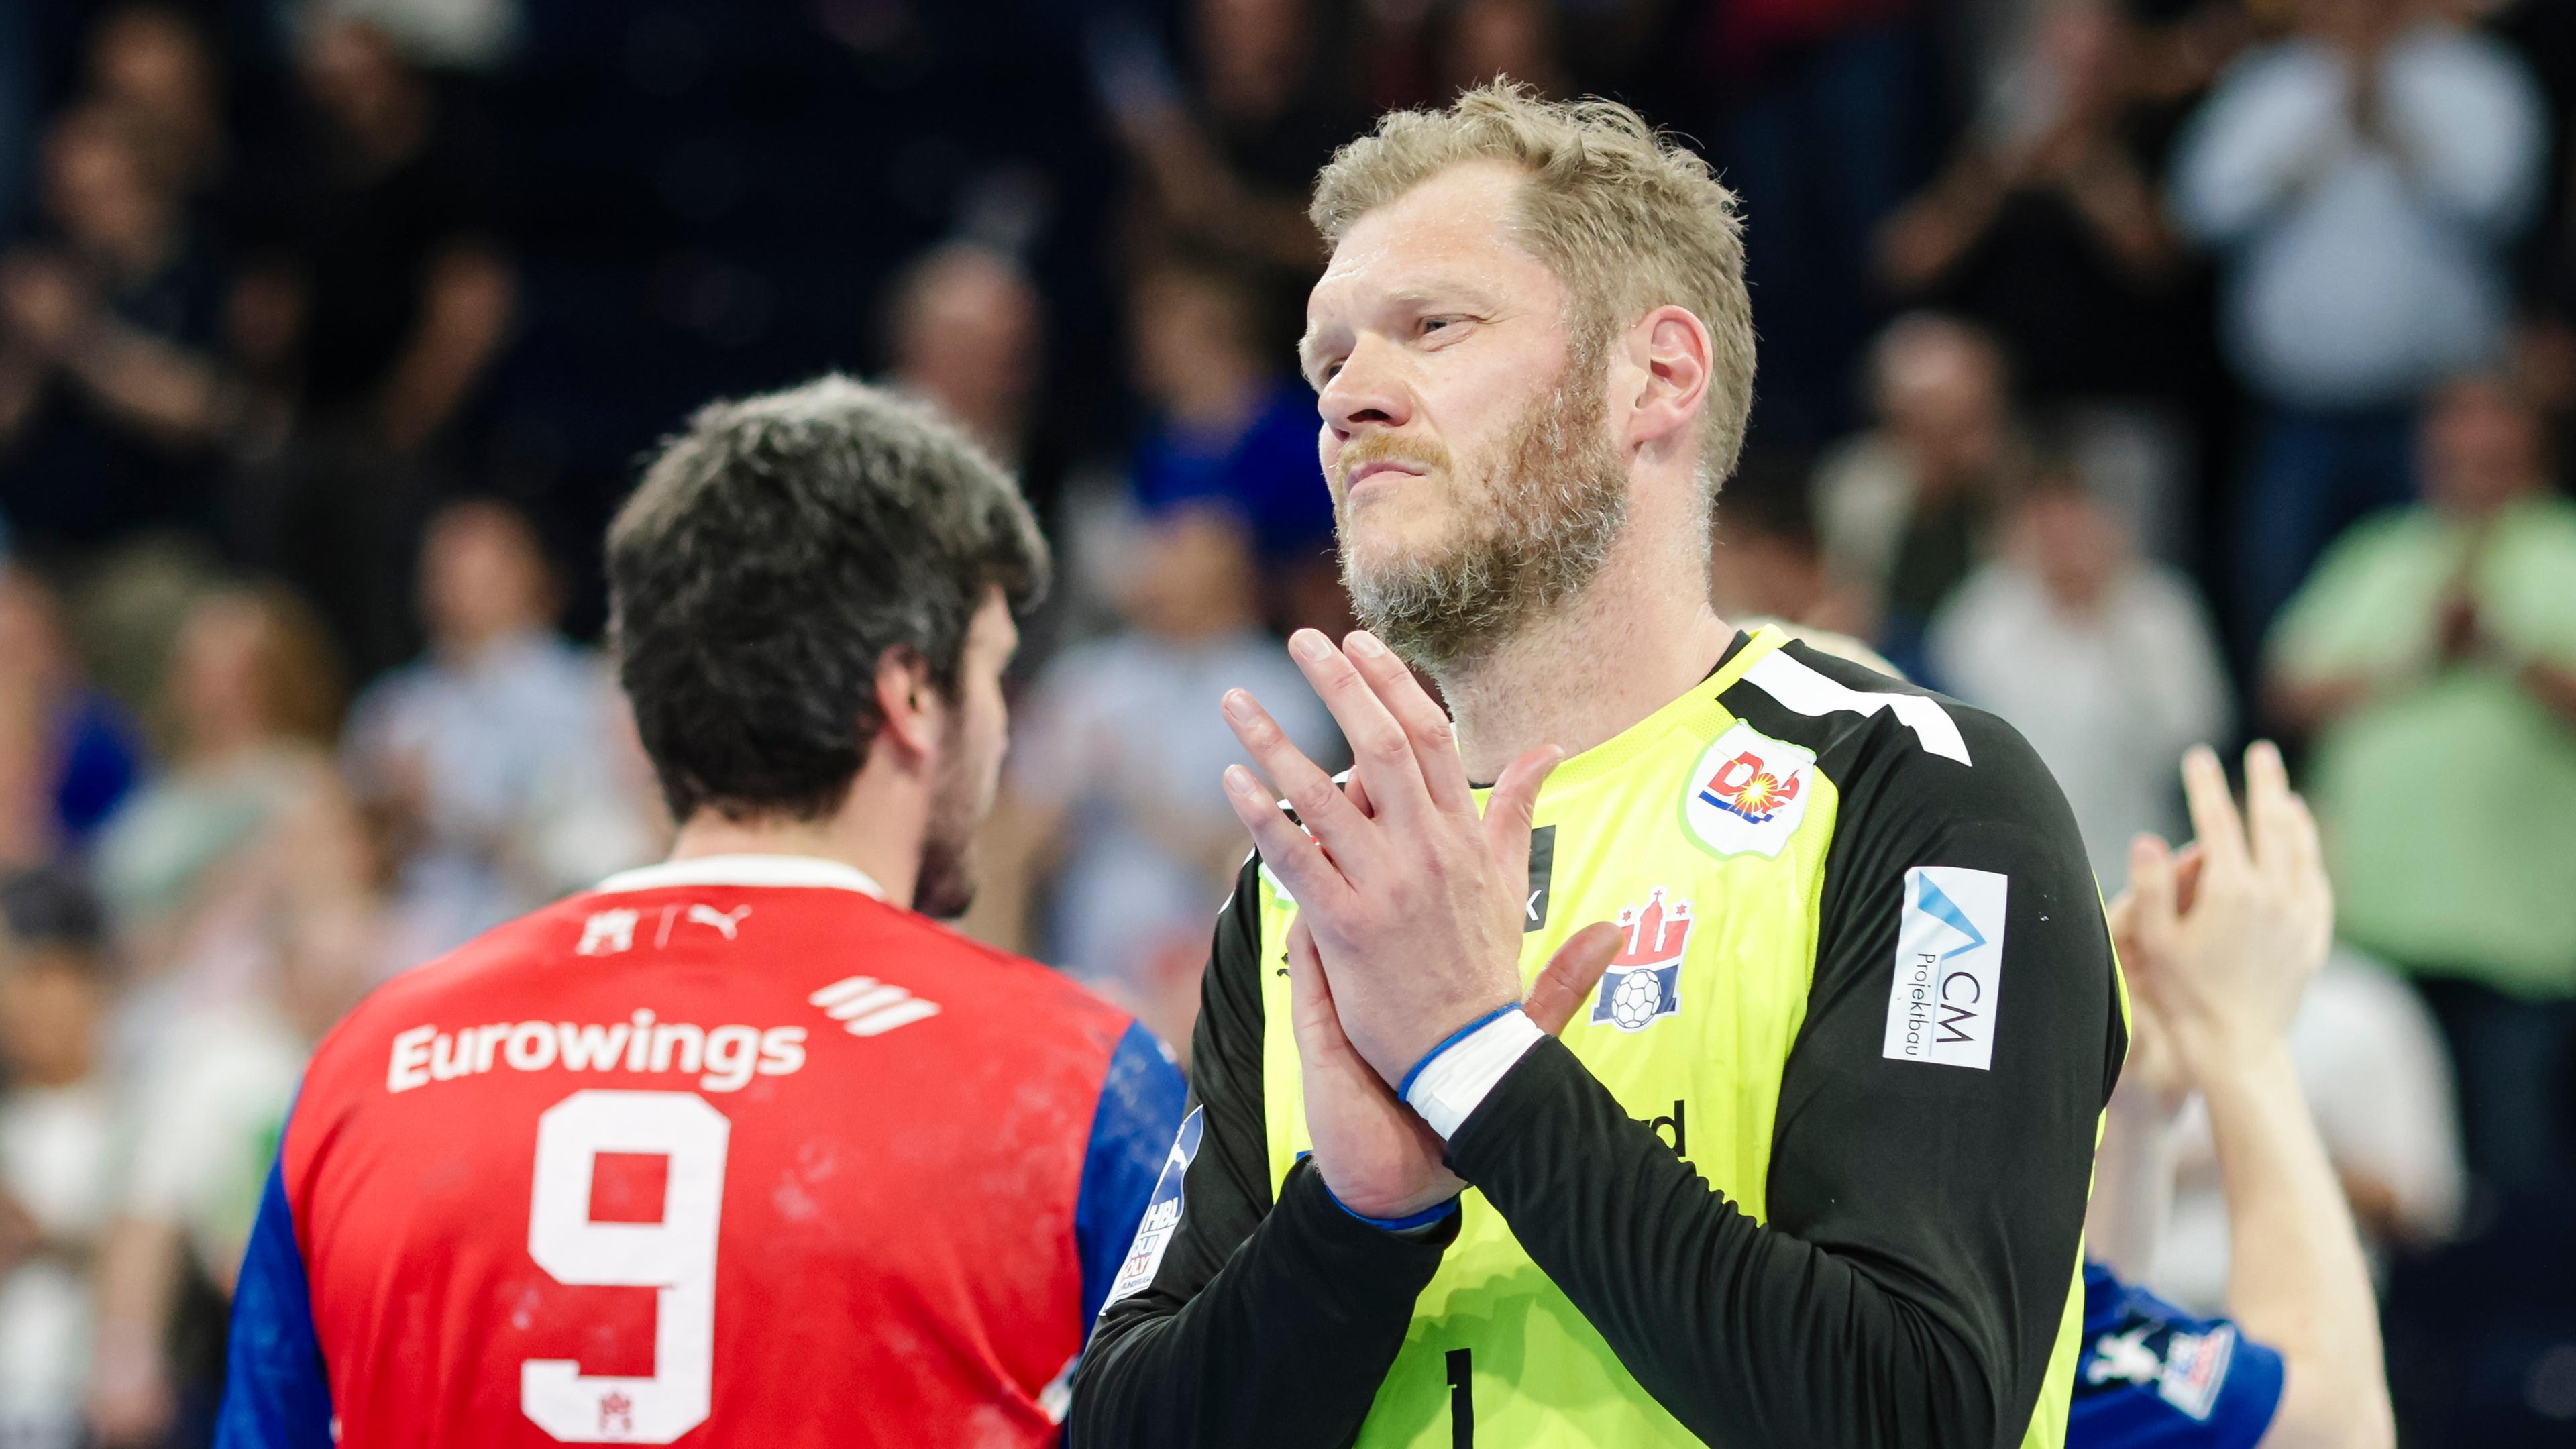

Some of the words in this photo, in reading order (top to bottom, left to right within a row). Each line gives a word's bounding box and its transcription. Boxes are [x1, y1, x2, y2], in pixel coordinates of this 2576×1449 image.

[1904, 953, 1937, 1056] Projektbau
[1936, 971, 1980, 1042] CM
[386, 1008, 808, 1092] Eurowings
[1142, 1197, 1179, 1233] HBL
[521, 1089, 731, 1444] 9
